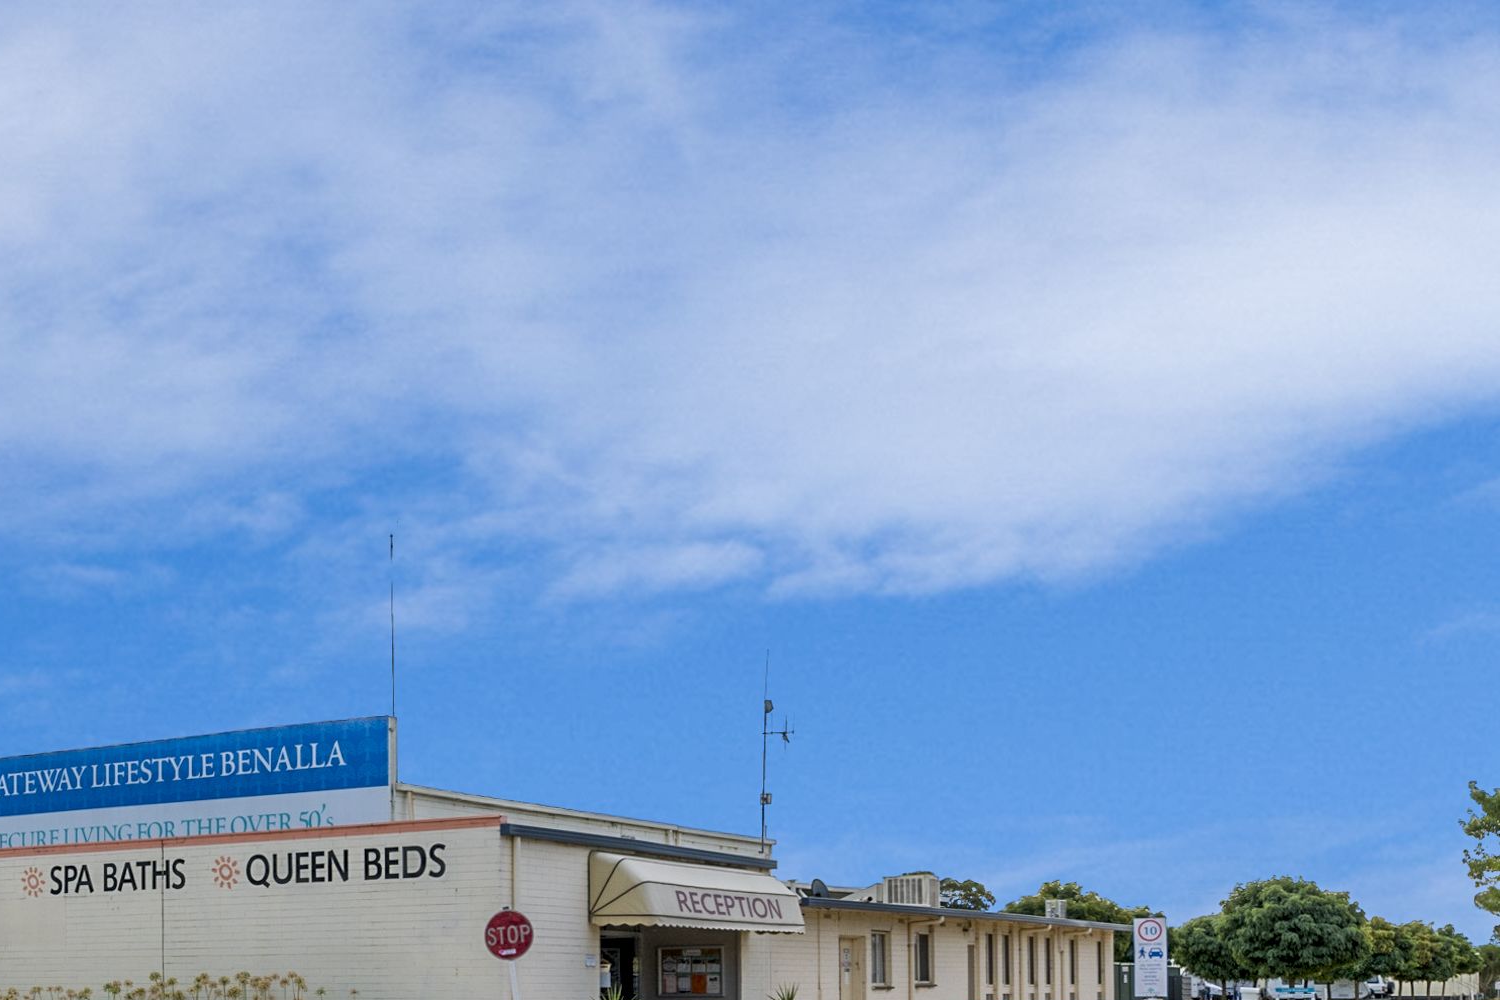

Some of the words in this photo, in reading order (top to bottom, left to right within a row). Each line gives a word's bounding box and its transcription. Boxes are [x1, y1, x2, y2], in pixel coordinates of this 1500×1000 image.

[91, 753, 215, 789] LIFESTYLE
[220, 740, 347, 776] BENALLA
[63, 823, 132, 845] LIVING
[137, 820, 175, 840] FOR
[181, 817, 226, 837] THE
[230, 812, 291, 833] OVER
[50, 865, 94, 895] SPA
[103, 858, 186, 892] BATHS
[246, 849, 349, 888] QUEEN
[364, 843, 446, 881] BEDS
[675, 890, 782, 919] RECEPTION
[487, 924, 530, 946] STOP
[1144, 926, 1157, 936] 10
